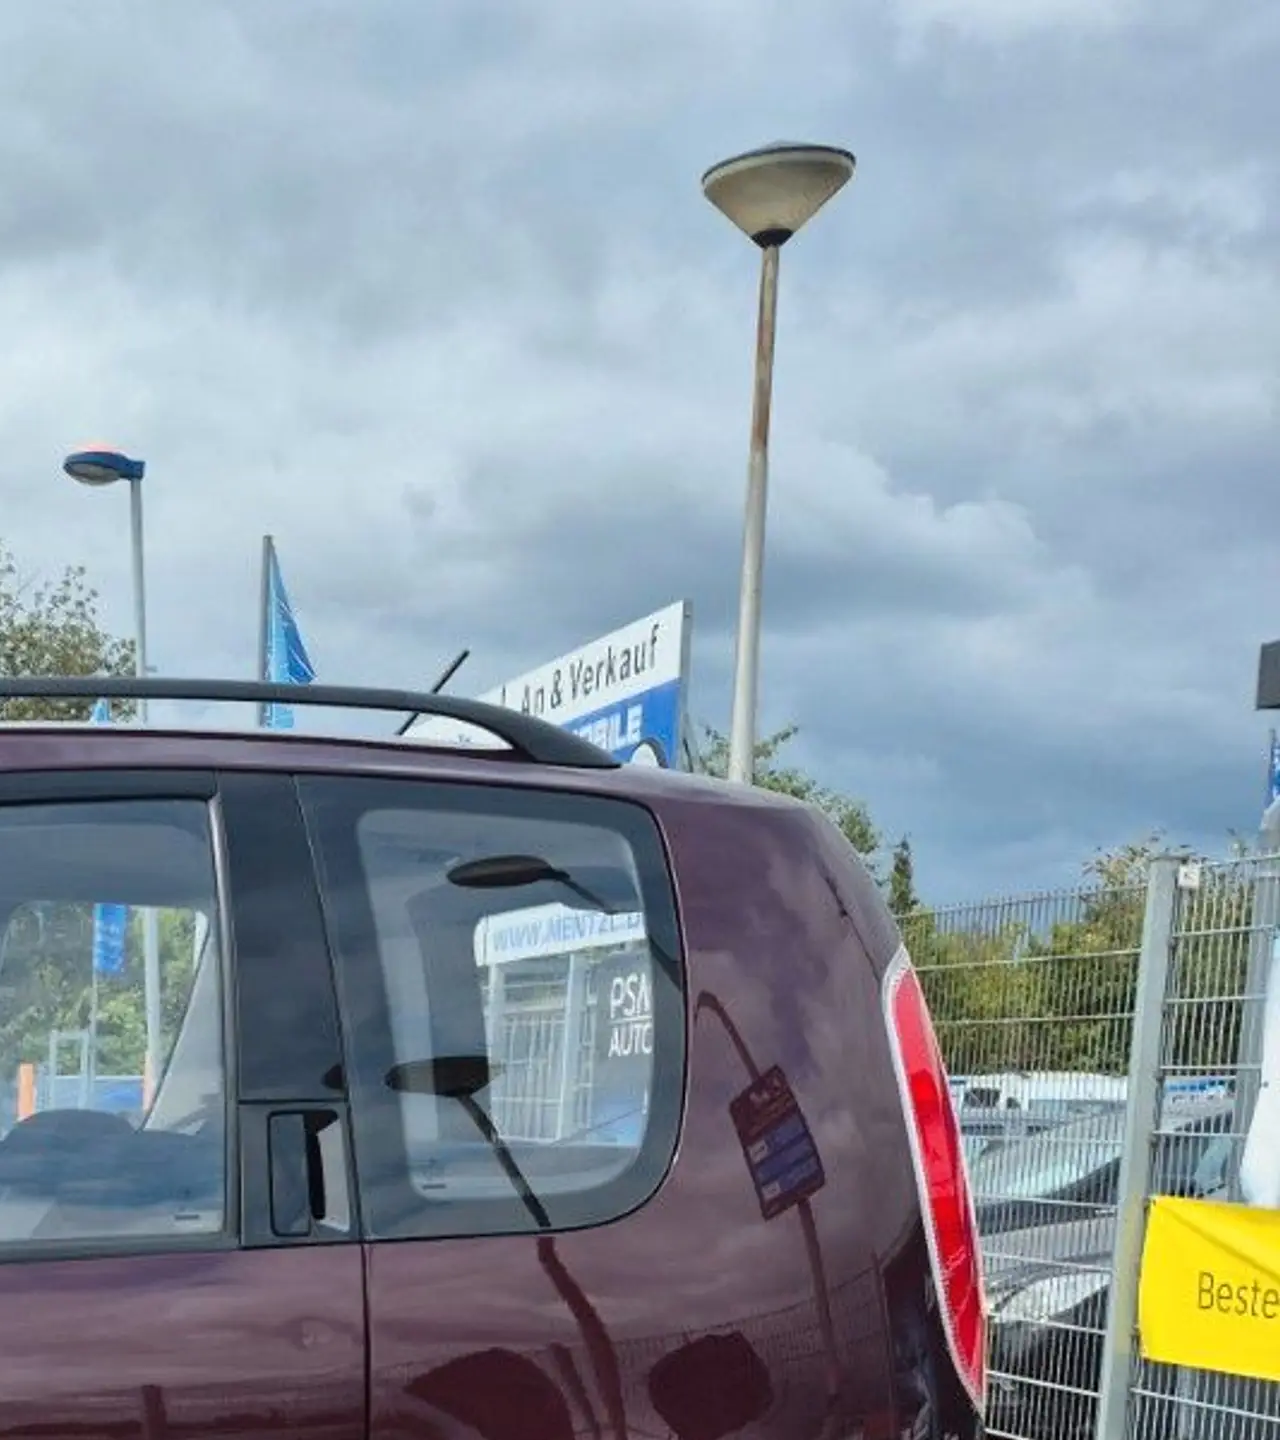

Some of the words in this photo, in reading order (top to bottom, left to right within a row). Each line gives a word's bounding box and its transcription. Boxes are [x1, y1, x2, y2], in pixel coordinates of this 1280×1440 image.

[550, 669, 562, 710] &
[570, 623, 660, 700] Verkauf
[1198, 1271, 1280, 1319] Beste
